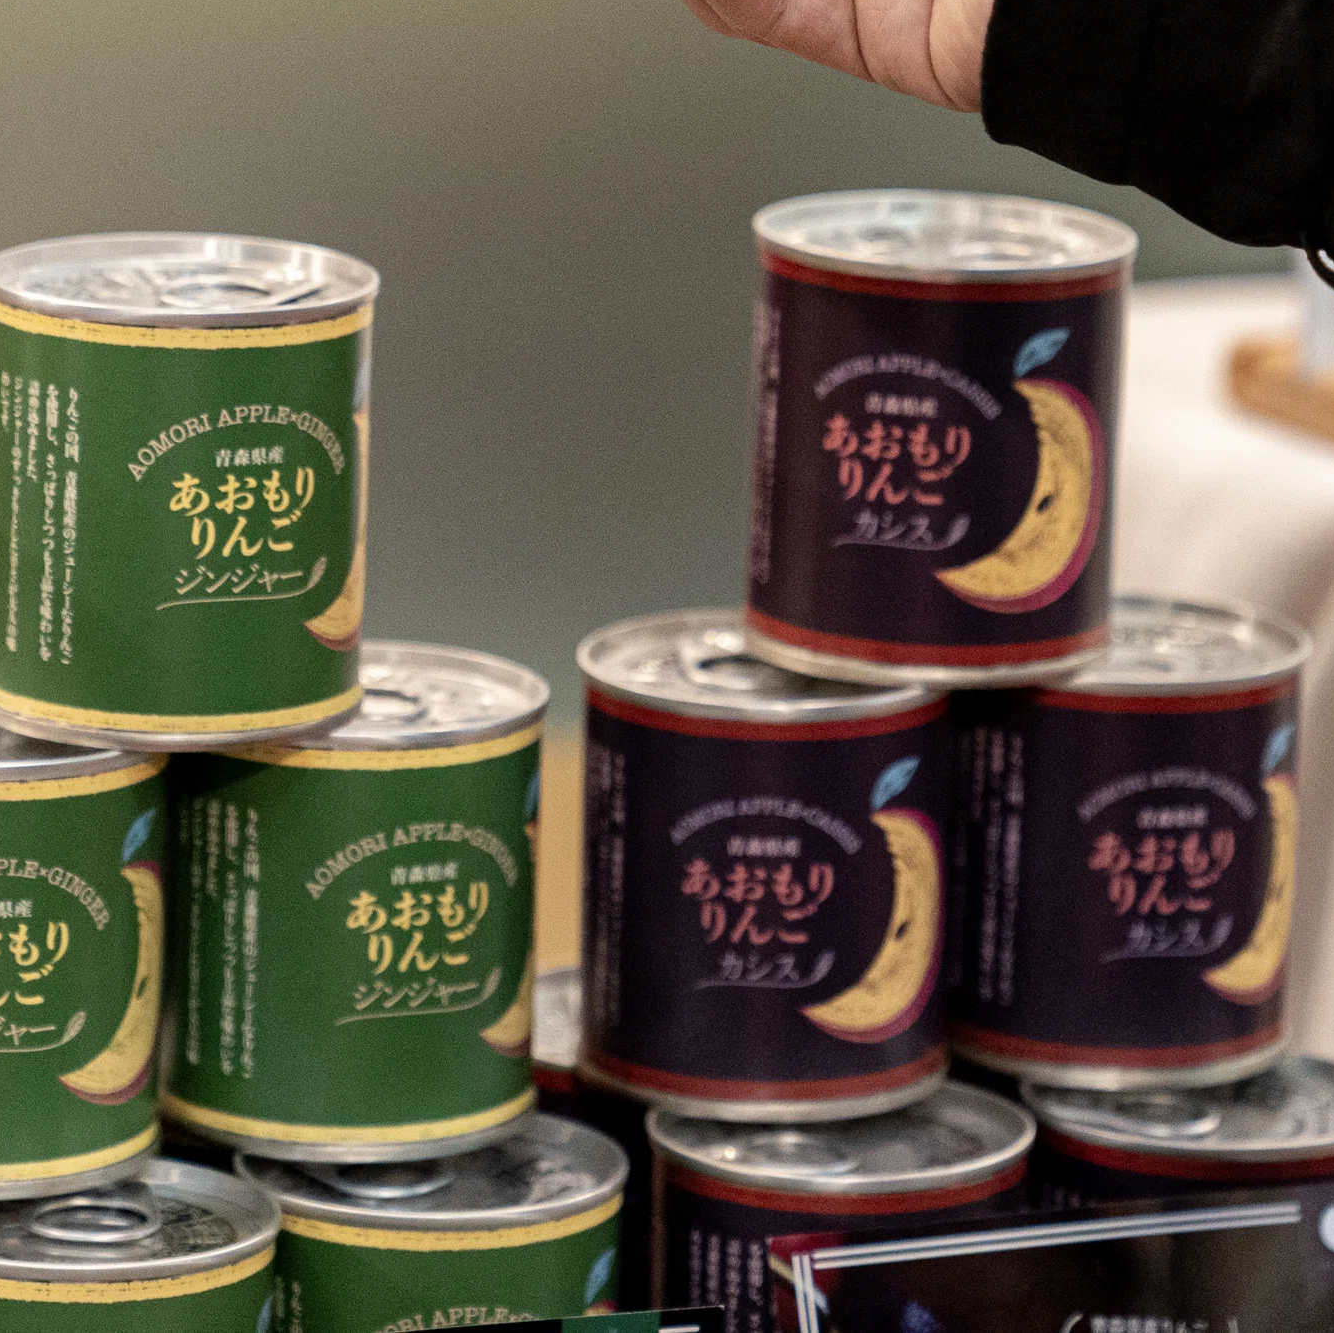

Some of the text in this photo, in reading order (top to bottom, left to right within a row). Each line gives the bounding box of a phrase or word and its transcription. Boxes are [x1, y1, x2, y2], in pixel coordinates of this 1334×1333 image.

[127, 413, 213, 482] AOMORI
[169, 467, 314, 516] あおもり
[191, 509, 302, 560] りんご
[175, 564, 304, 595] ジンジャー
[305, 832, 388, 899] AOMORI
[346, 881, 489, 934] あおもり
[368, 923, 477, 976] りんご
